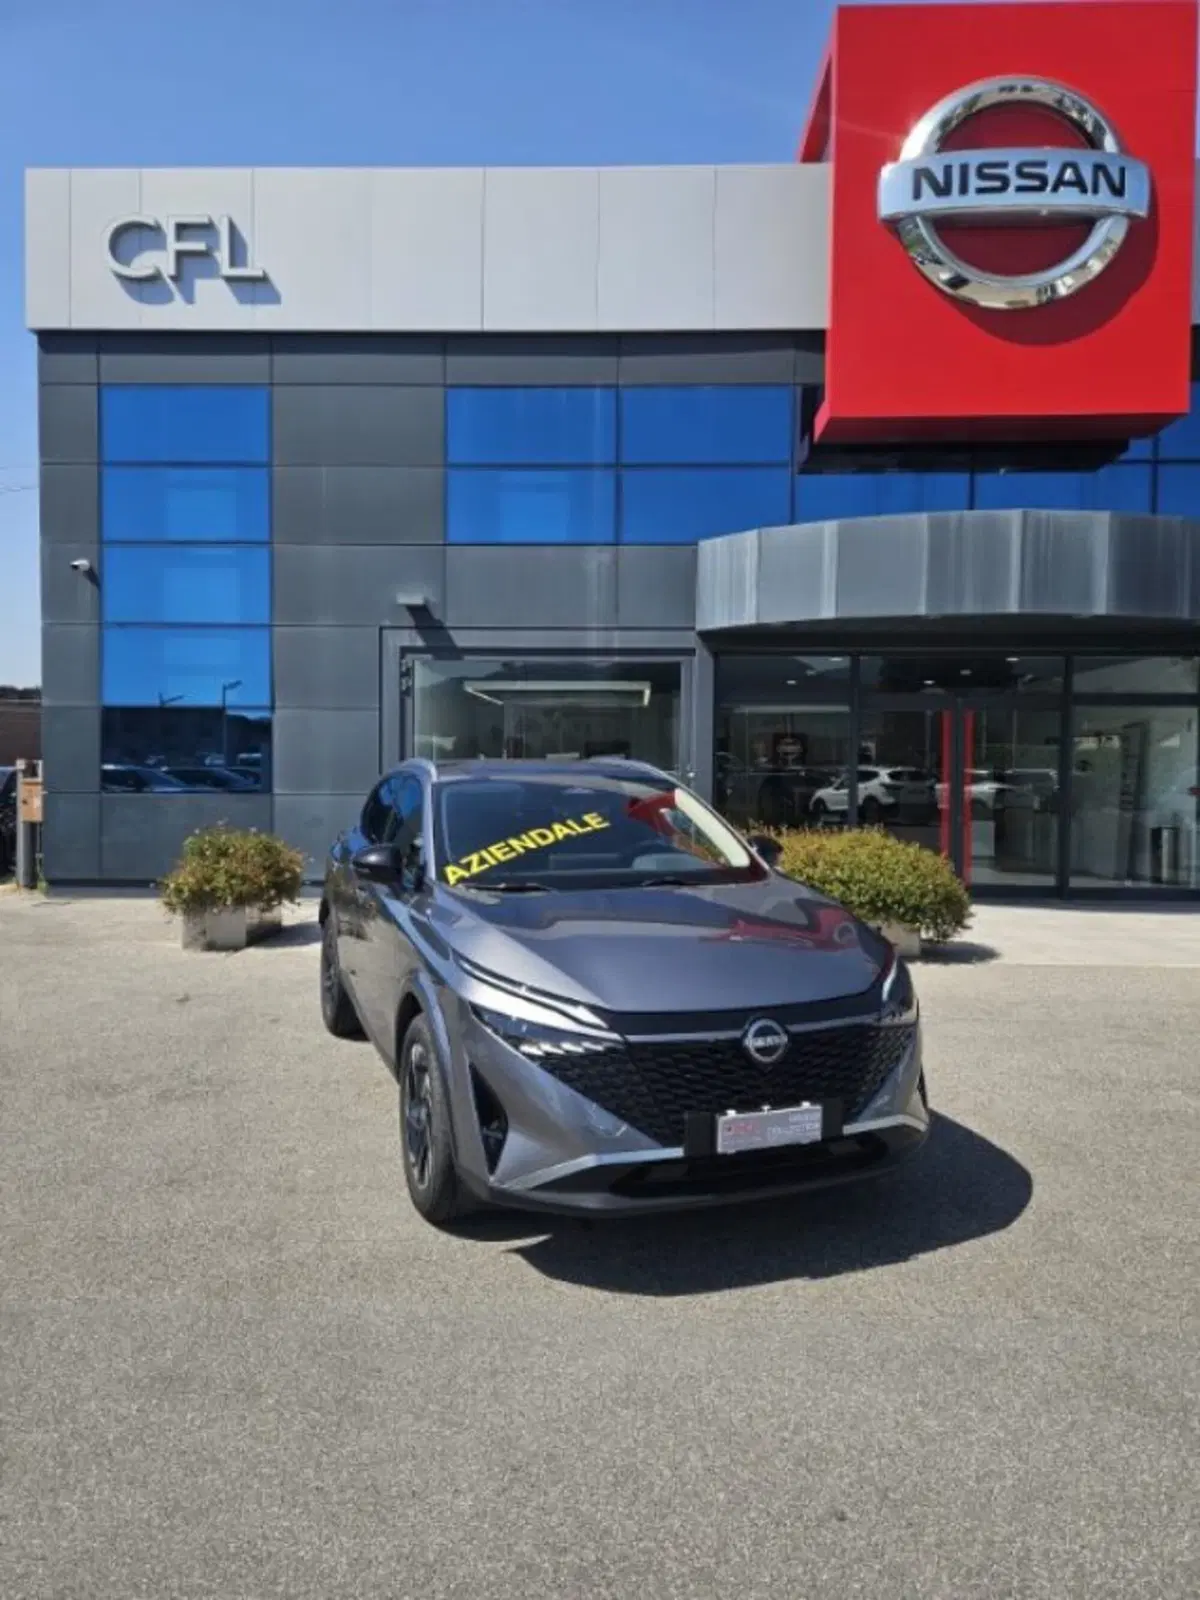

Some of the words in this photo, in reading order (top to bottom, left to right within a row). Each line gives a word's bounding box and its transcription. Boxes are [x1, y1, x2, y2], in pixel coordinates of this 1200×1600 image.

[912, 160, 1126, 201] NISSAN
[106, 214, 264, 280] CFL
[443, 811, 611, 886] AZIENDALE
